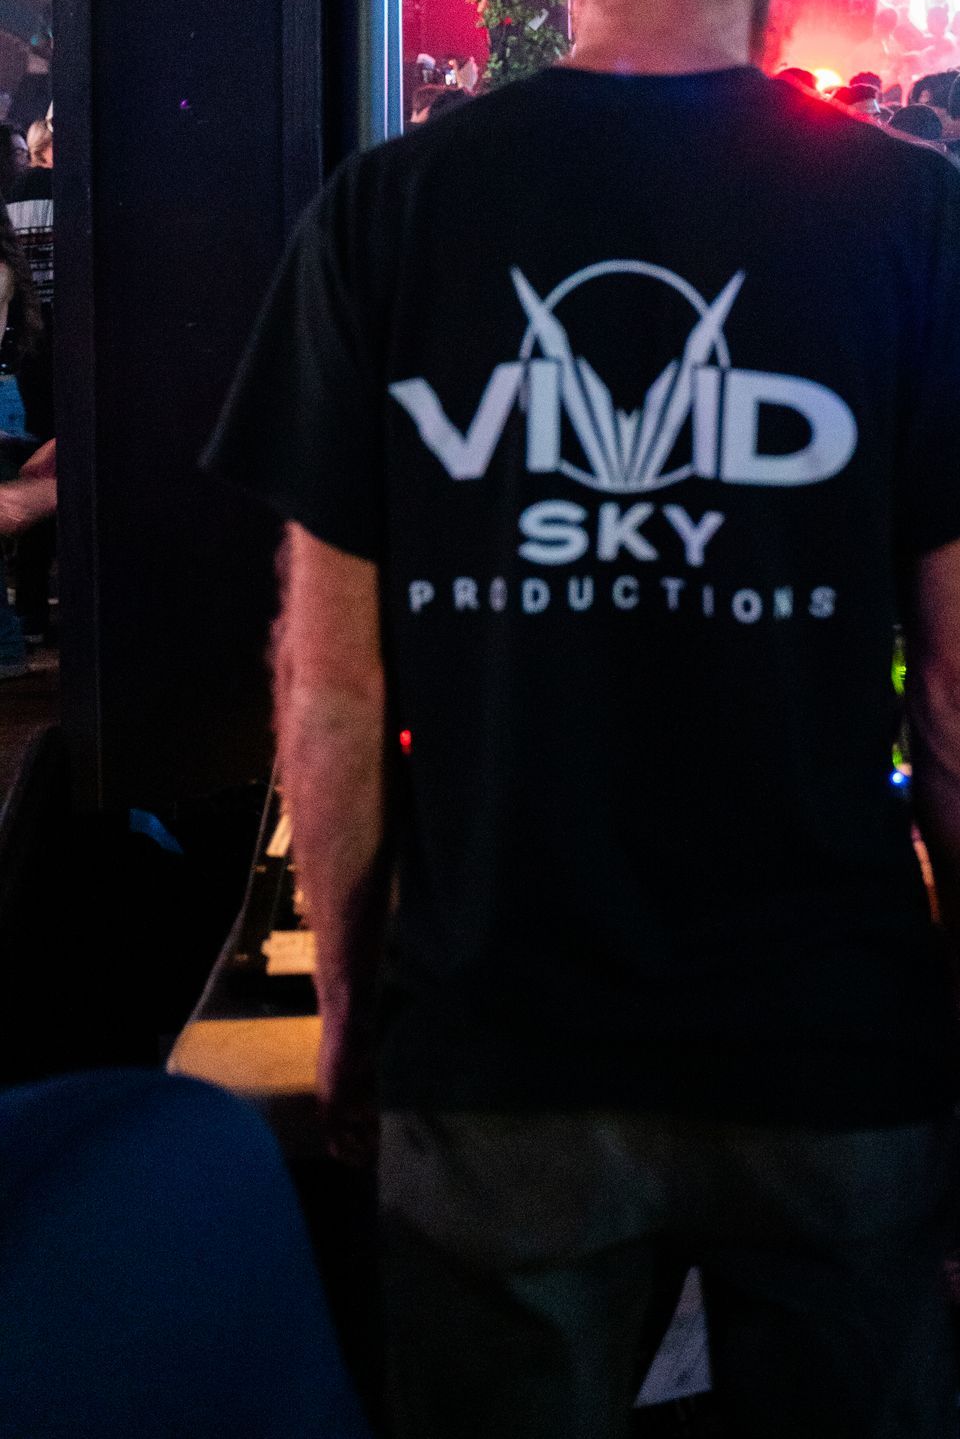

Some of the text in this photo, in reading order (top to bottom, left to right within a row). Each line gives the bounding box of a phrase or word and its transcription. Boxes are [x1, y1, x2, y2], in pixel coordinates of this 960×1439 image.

[388, 265, 858, 493] VIVID
[517, 499, 725, 567] SKY
[408, 575, 837, 624] PRODUCTIONS
